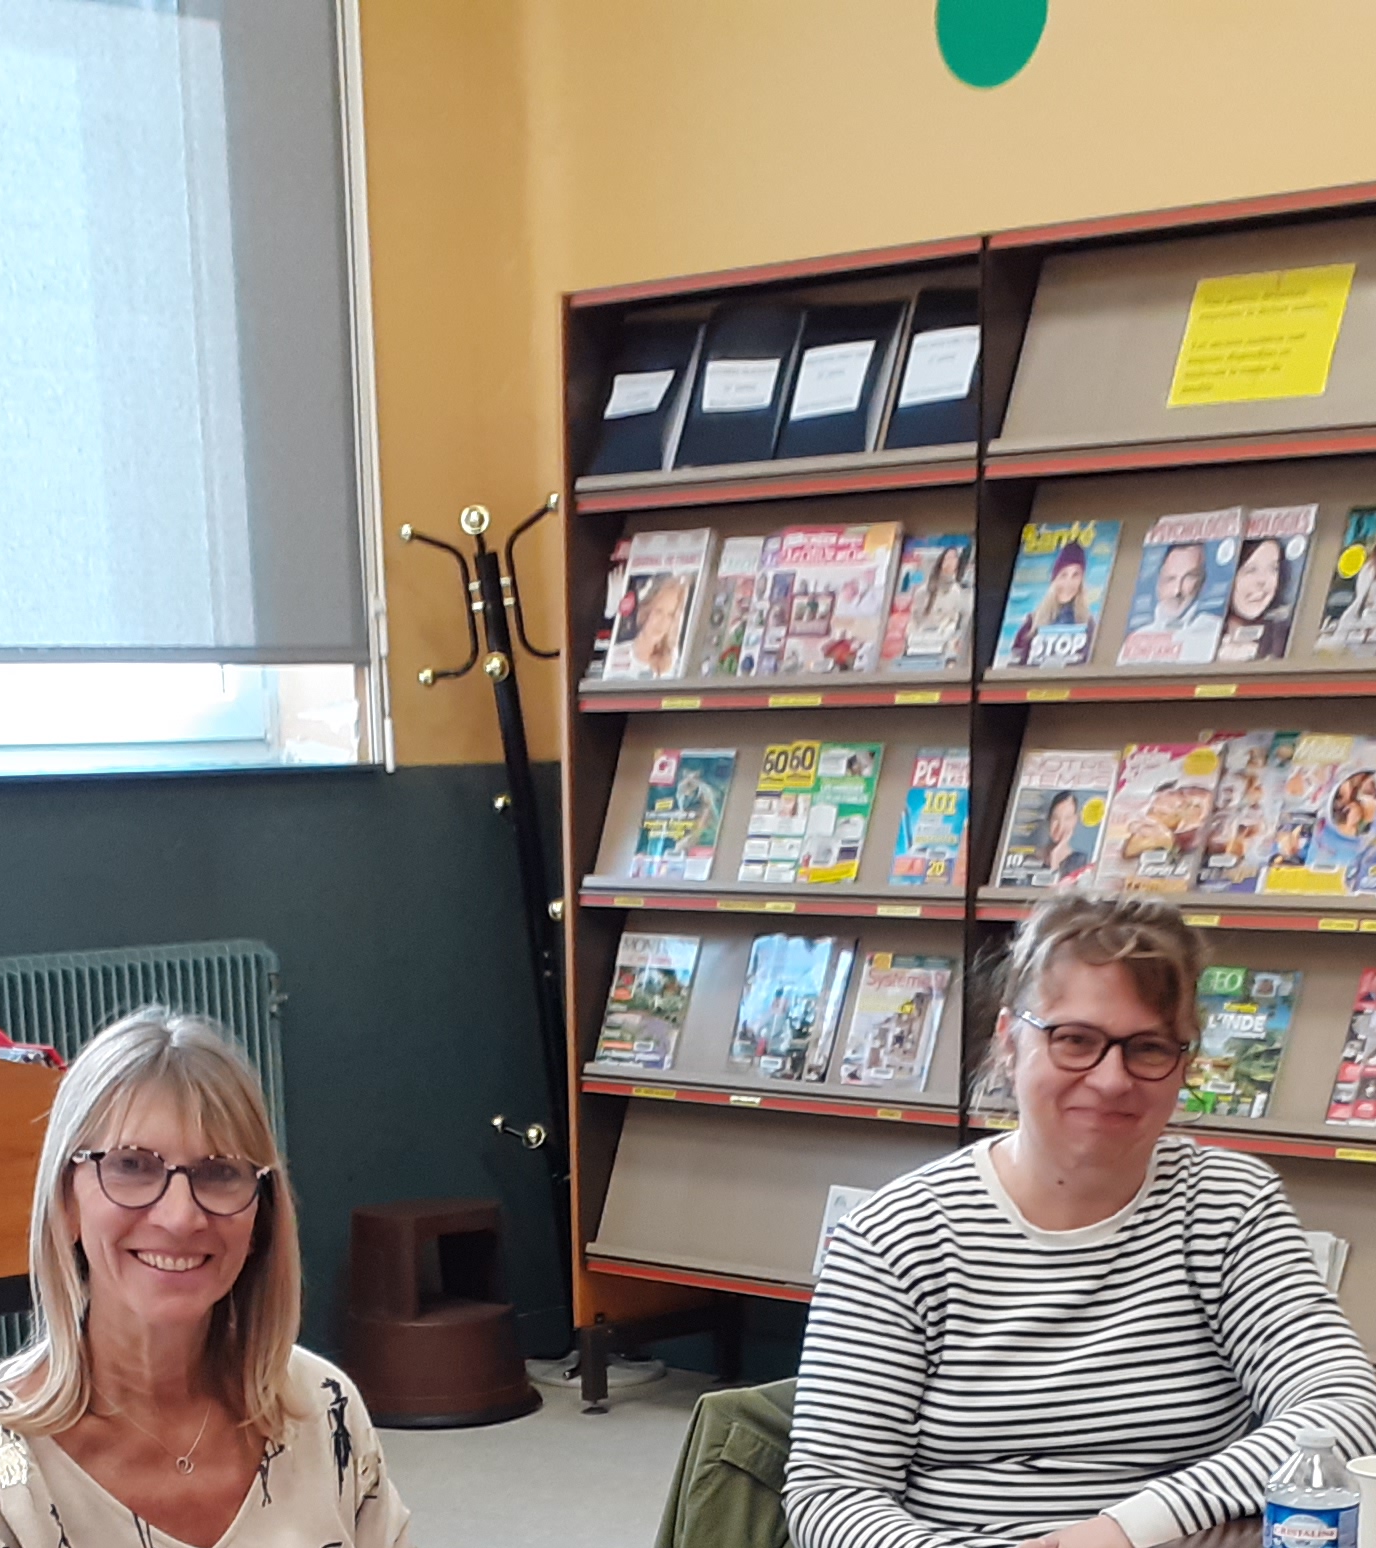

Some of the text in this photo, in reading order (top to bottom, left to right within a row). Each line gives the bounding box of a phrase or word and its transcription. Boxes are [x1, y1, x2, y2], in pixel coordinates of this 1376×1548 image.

[1030, 632, 1087, 657] STOP
[763, 749, 789, 774] 60
[789, 745, 815, 771] 60
[913, 758, 940, 786] PC
[924, 790, 958, 816] 101
[927, 859, 945, 877] 20
[1206, 1013, 1268, 1032] L'INDE
